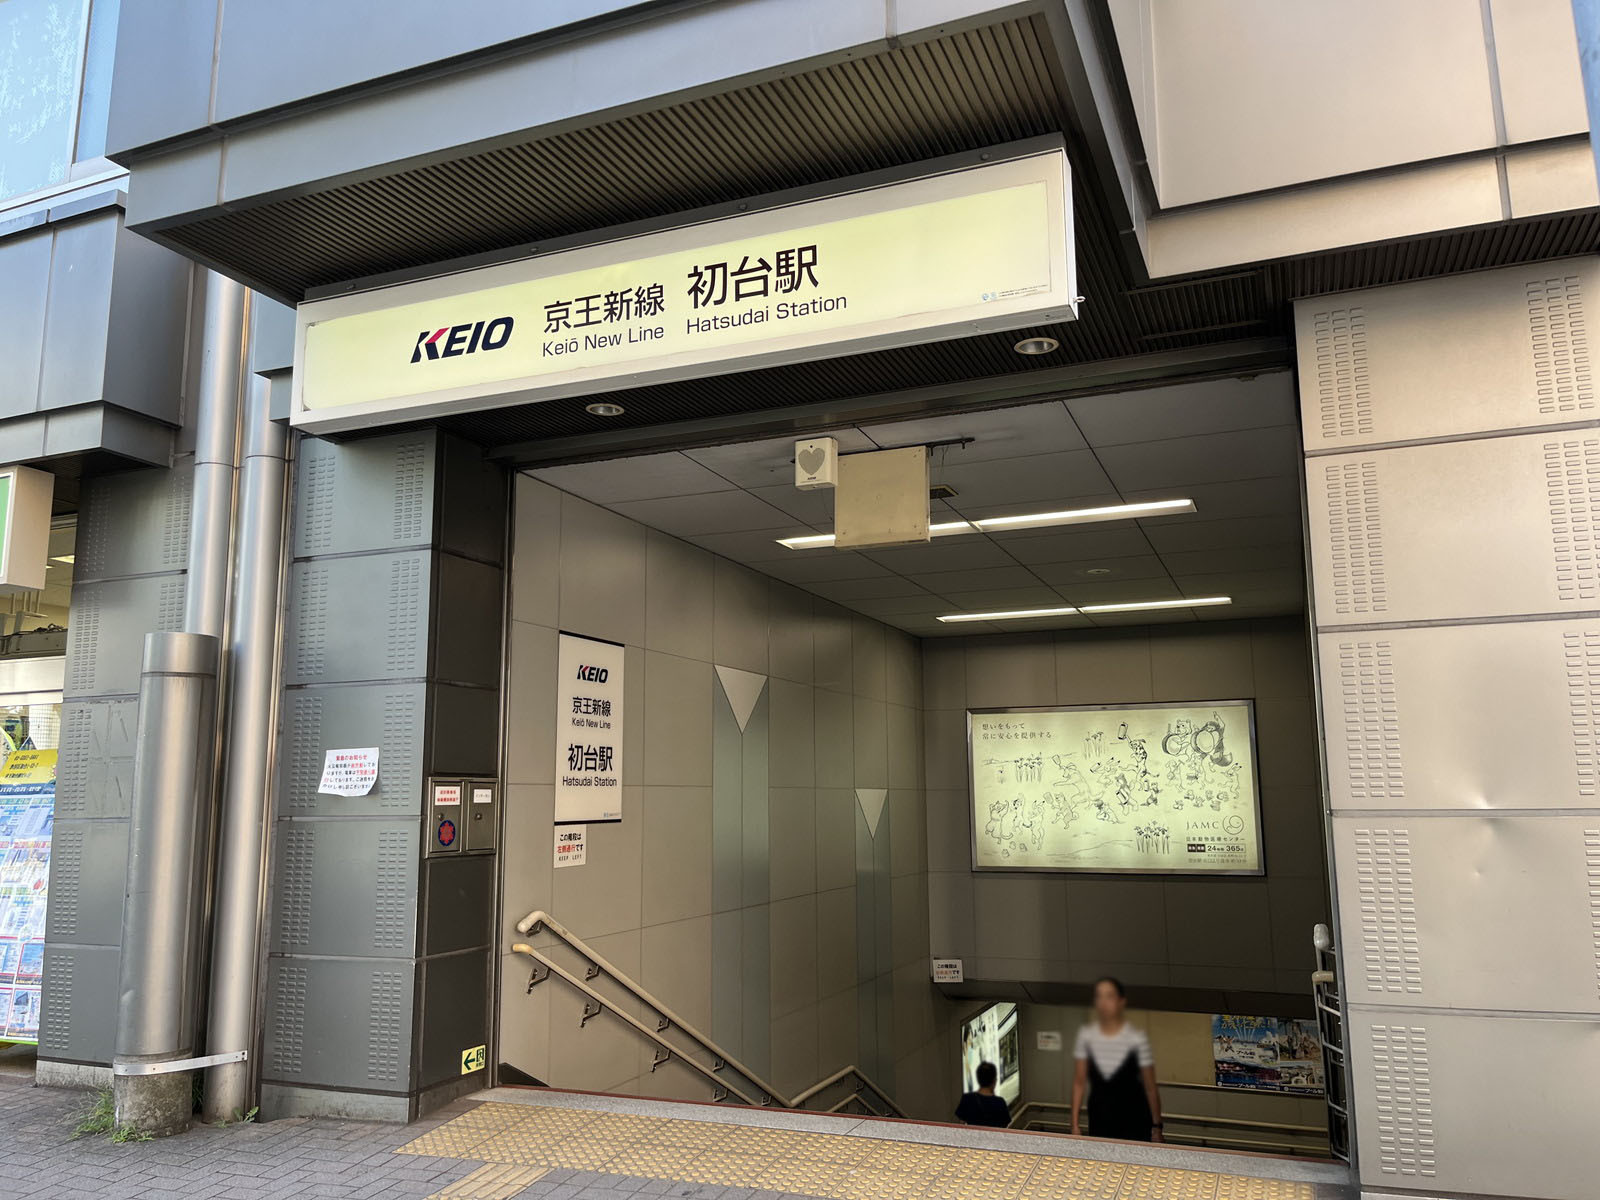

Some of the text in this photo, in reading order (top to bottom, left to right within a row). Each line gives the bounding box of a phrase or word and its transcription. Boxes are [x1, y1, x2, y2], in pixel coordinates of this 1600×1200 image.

[687, 244, 819, 309] 初台駅
[543, 283, 665, 334] 京王新線
[686, 296, 847, 335] Hatsudai Station
[410, 316, 514, 364] KEIO
[542, 326, 665, 357] Keiō New Line
[577, 664, 609, 684] KEIO
[572, 696, 611, 717] 京王新線
[585, 718, 599, 728] New
[599, 719, 611, 729] Line
[982, 731, 1052, 739] 常に安心を提供する
[567, 743, 613, 772] 初台駅
[562, 776, 617, 787] Hatsudai Station
[1186, 821, 1219, 830] JAMC
